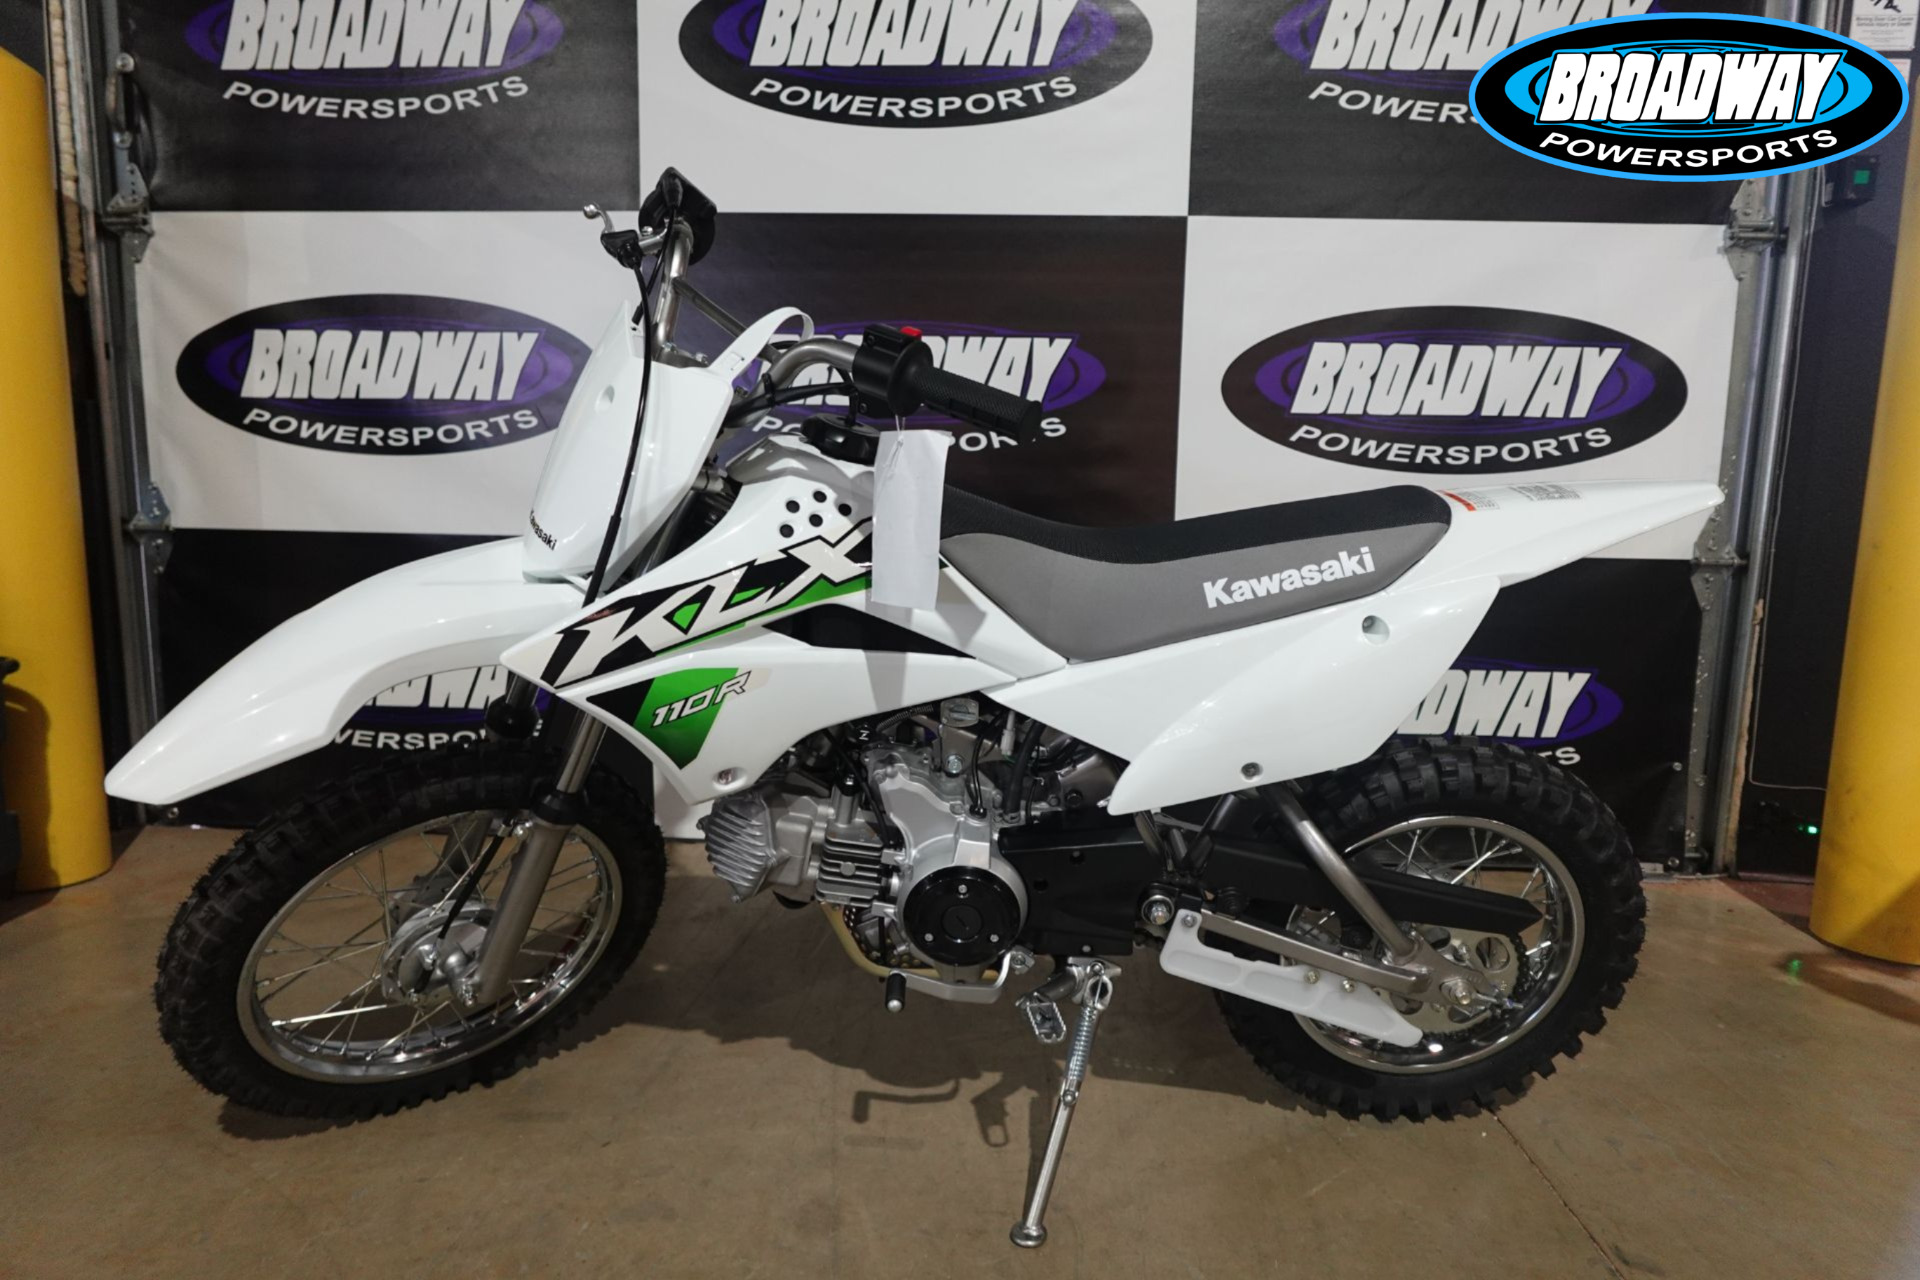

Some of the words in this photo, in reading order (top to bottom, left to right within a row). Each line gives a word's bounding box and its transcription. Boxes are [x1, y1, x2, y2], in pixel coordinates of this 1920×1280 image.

[221, 0, 526, 70] BROADWAY
[750, 0, 1078, 66] BROADWAY
[223, 76, 529, 119] POWERSPORTS
[750, 76, 1077, 118] POWERSPORTS
[240, 329, 539, 400] BROADWAY
[1290, 342, 1622, 418] BROADWAY
[243, 408, 539, 446] POWERSPORTS
[1289, 425, 1612, 465] POWERSPORTS
[552, 519, 873, 688] KLX
[1203, 546, 1375, 608] Kawasaki
